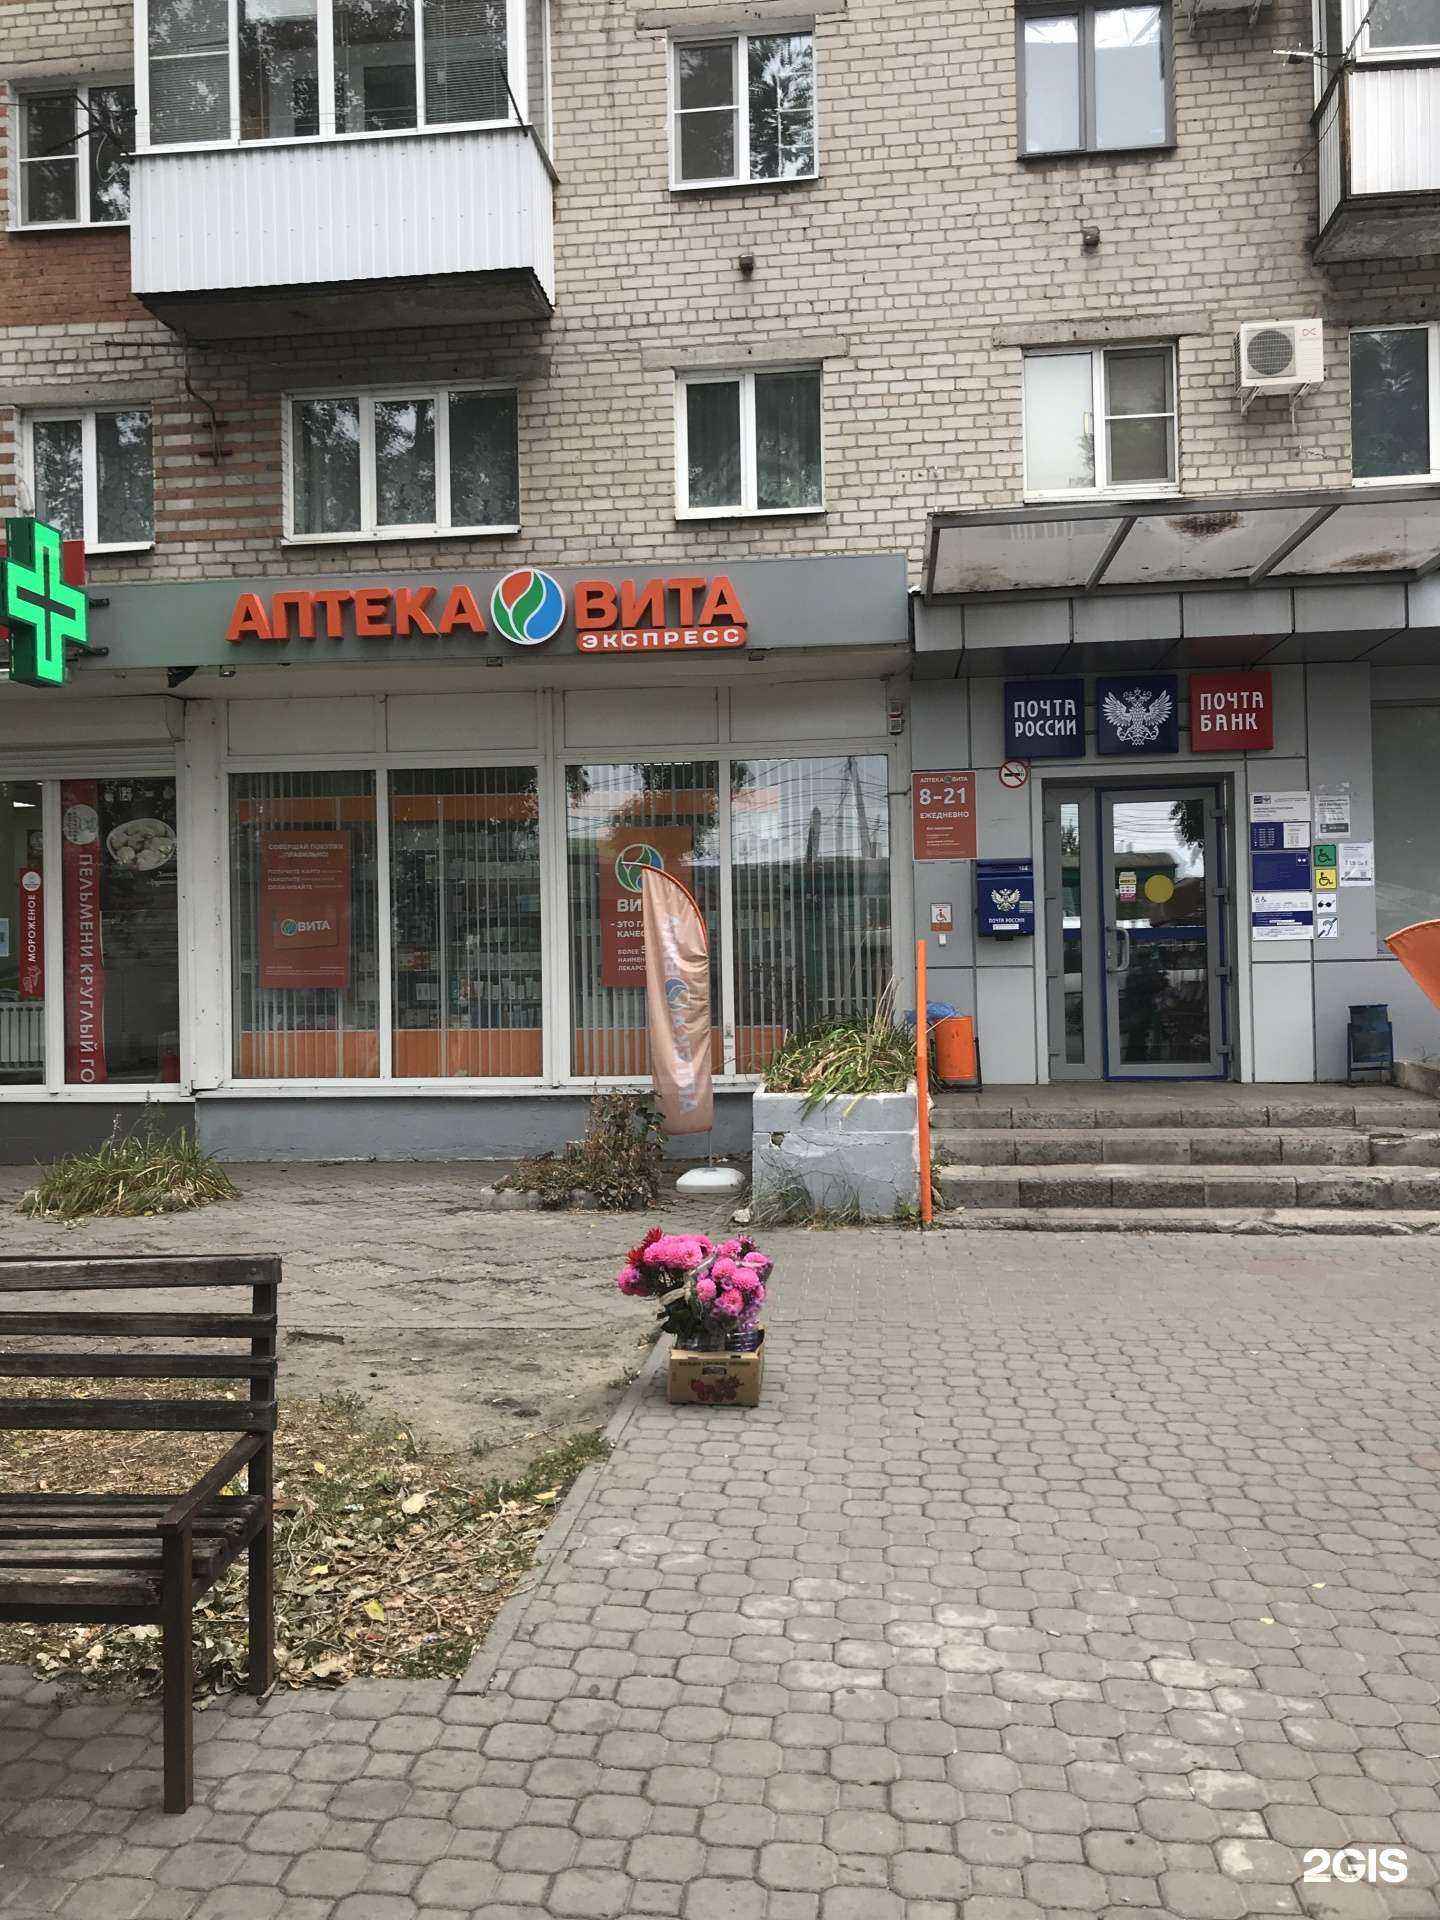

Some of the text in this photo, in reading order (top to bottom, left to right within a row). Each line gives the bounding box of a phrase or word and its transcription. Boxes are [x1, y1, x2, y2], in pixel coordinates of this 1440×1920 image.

[225, 575, 748, 641] АПТЕКА ВИТА
[581, 627, 741, 649] ЭКСПРЕСС
[1014, 699, 1077, 718] ПОЧТА
[1200, 691, 1264, 710] ПОЧТА
[1014, 719, 1077, 737] РОССИИ
[1200, 713, 1258, 732] БАНК
[919, 787, 966, 805] 8-21
[920, 811, 970, 819] ЕЖЕДНЕВНО
[616, 898, 643, 913] ВИ
[27, 894, 37, 962] МОРОЖЕНОЕ
[298, 920, 331, 932] ВИТА
[616, 920, 634, 928] ЭТО
[79, 854, 98, 1083] ПЕЛЬМЕНИ КРУГЛЫЙ ГО
